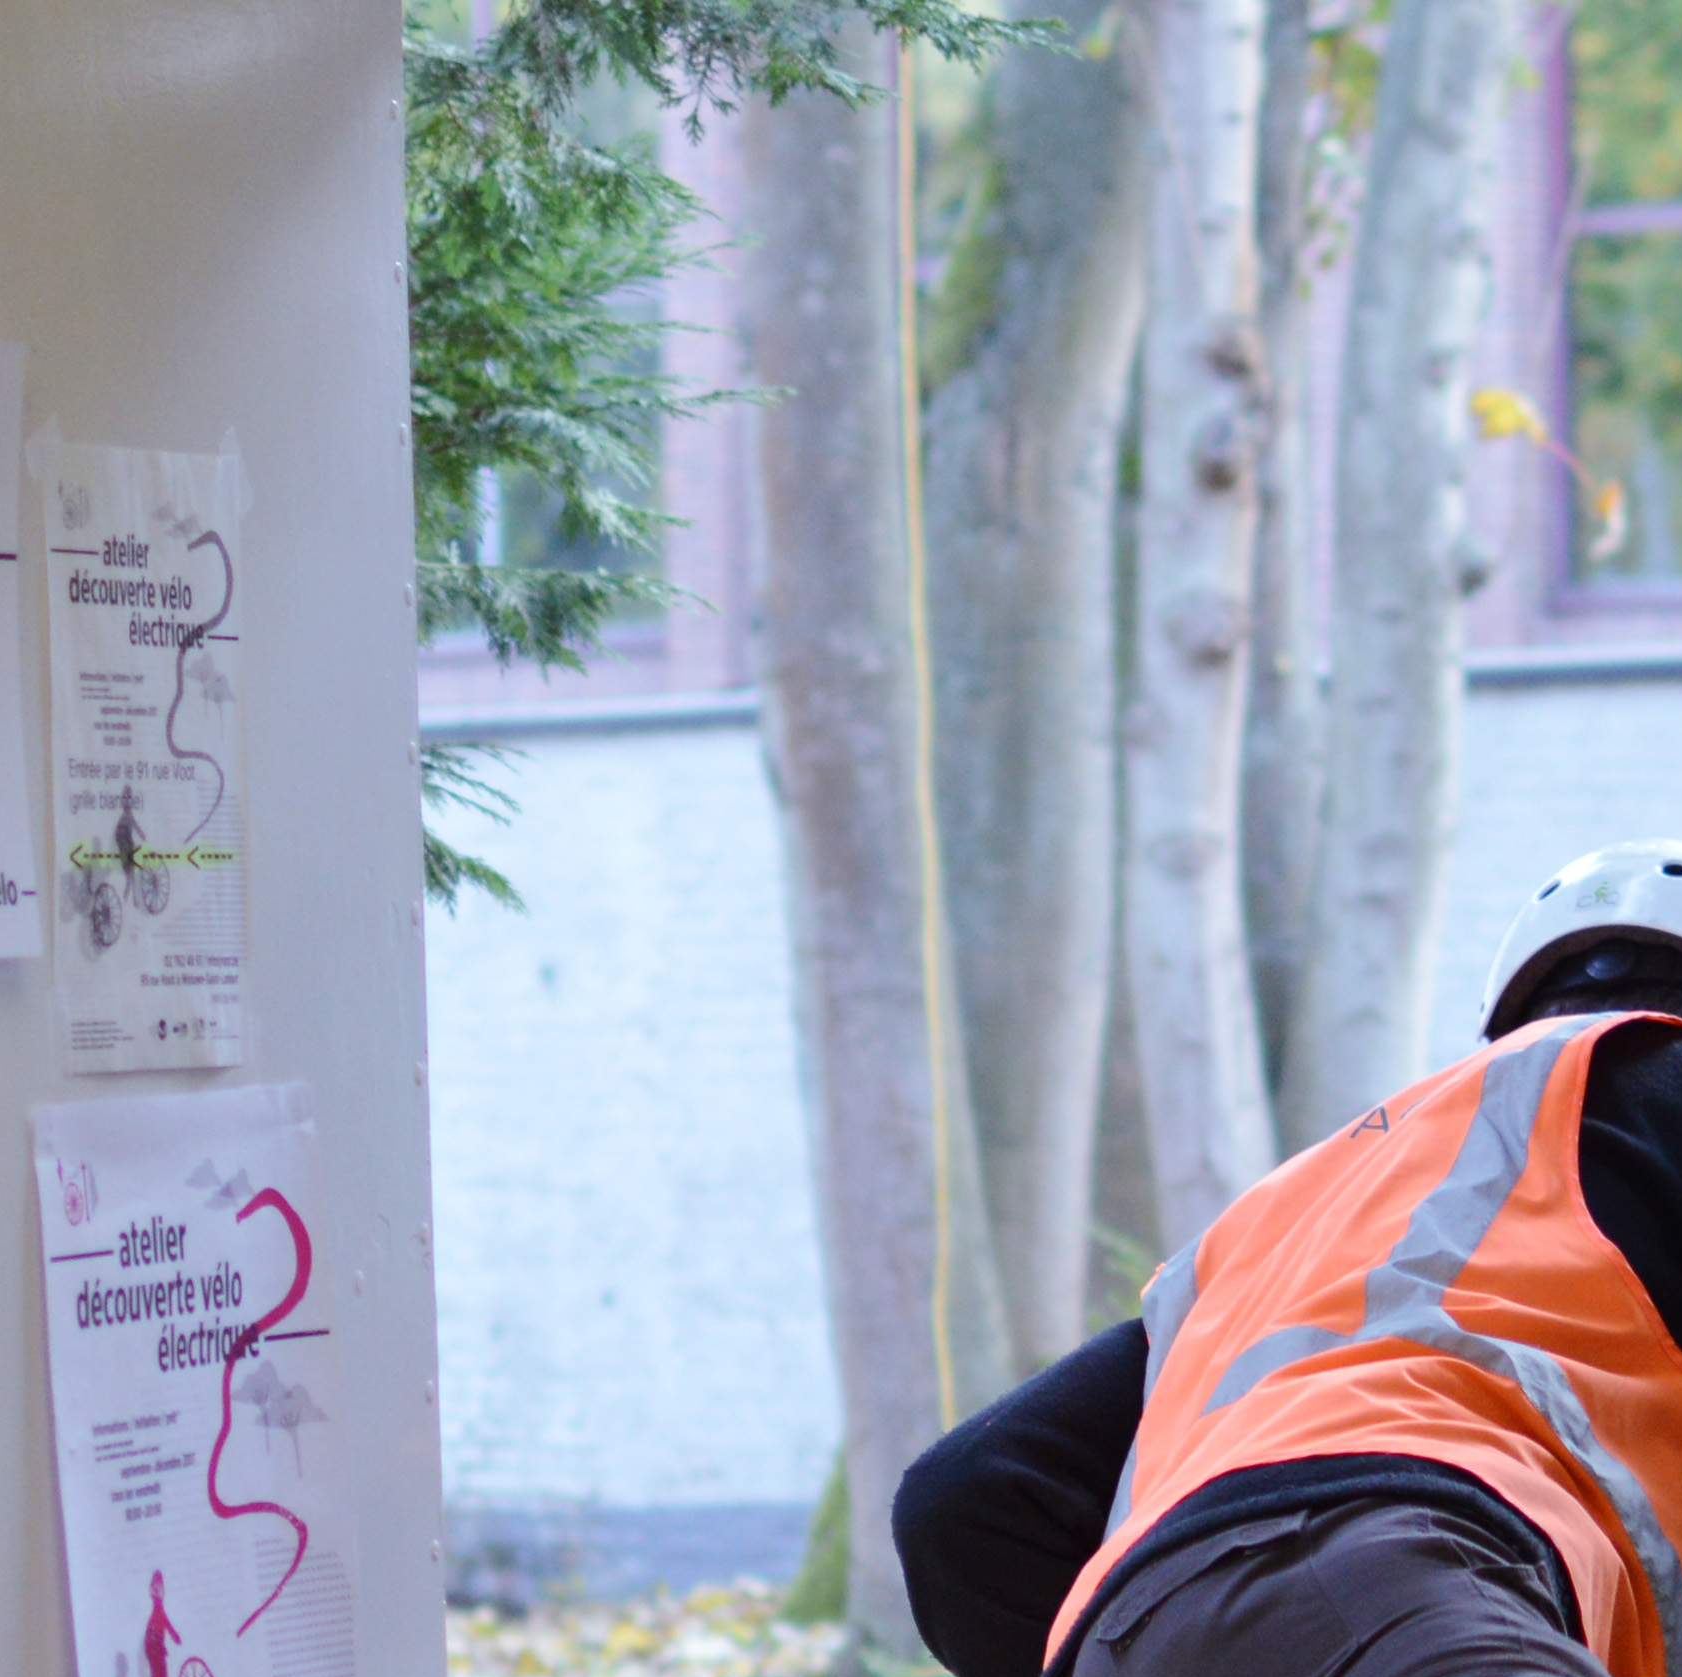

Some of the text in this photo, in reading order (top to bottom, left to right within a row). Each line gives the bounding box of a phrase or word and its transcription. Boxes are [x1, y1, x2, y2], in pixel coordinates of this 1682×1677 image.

[103, 534, 150, 569] atelier
[70, 569, 192, 611] découverte vélo
[120, 1215, 186, 1268] atelier
[77, 1261, 242, 1329] découverte vélo
[158, 1316, 260, 1372] électrique
